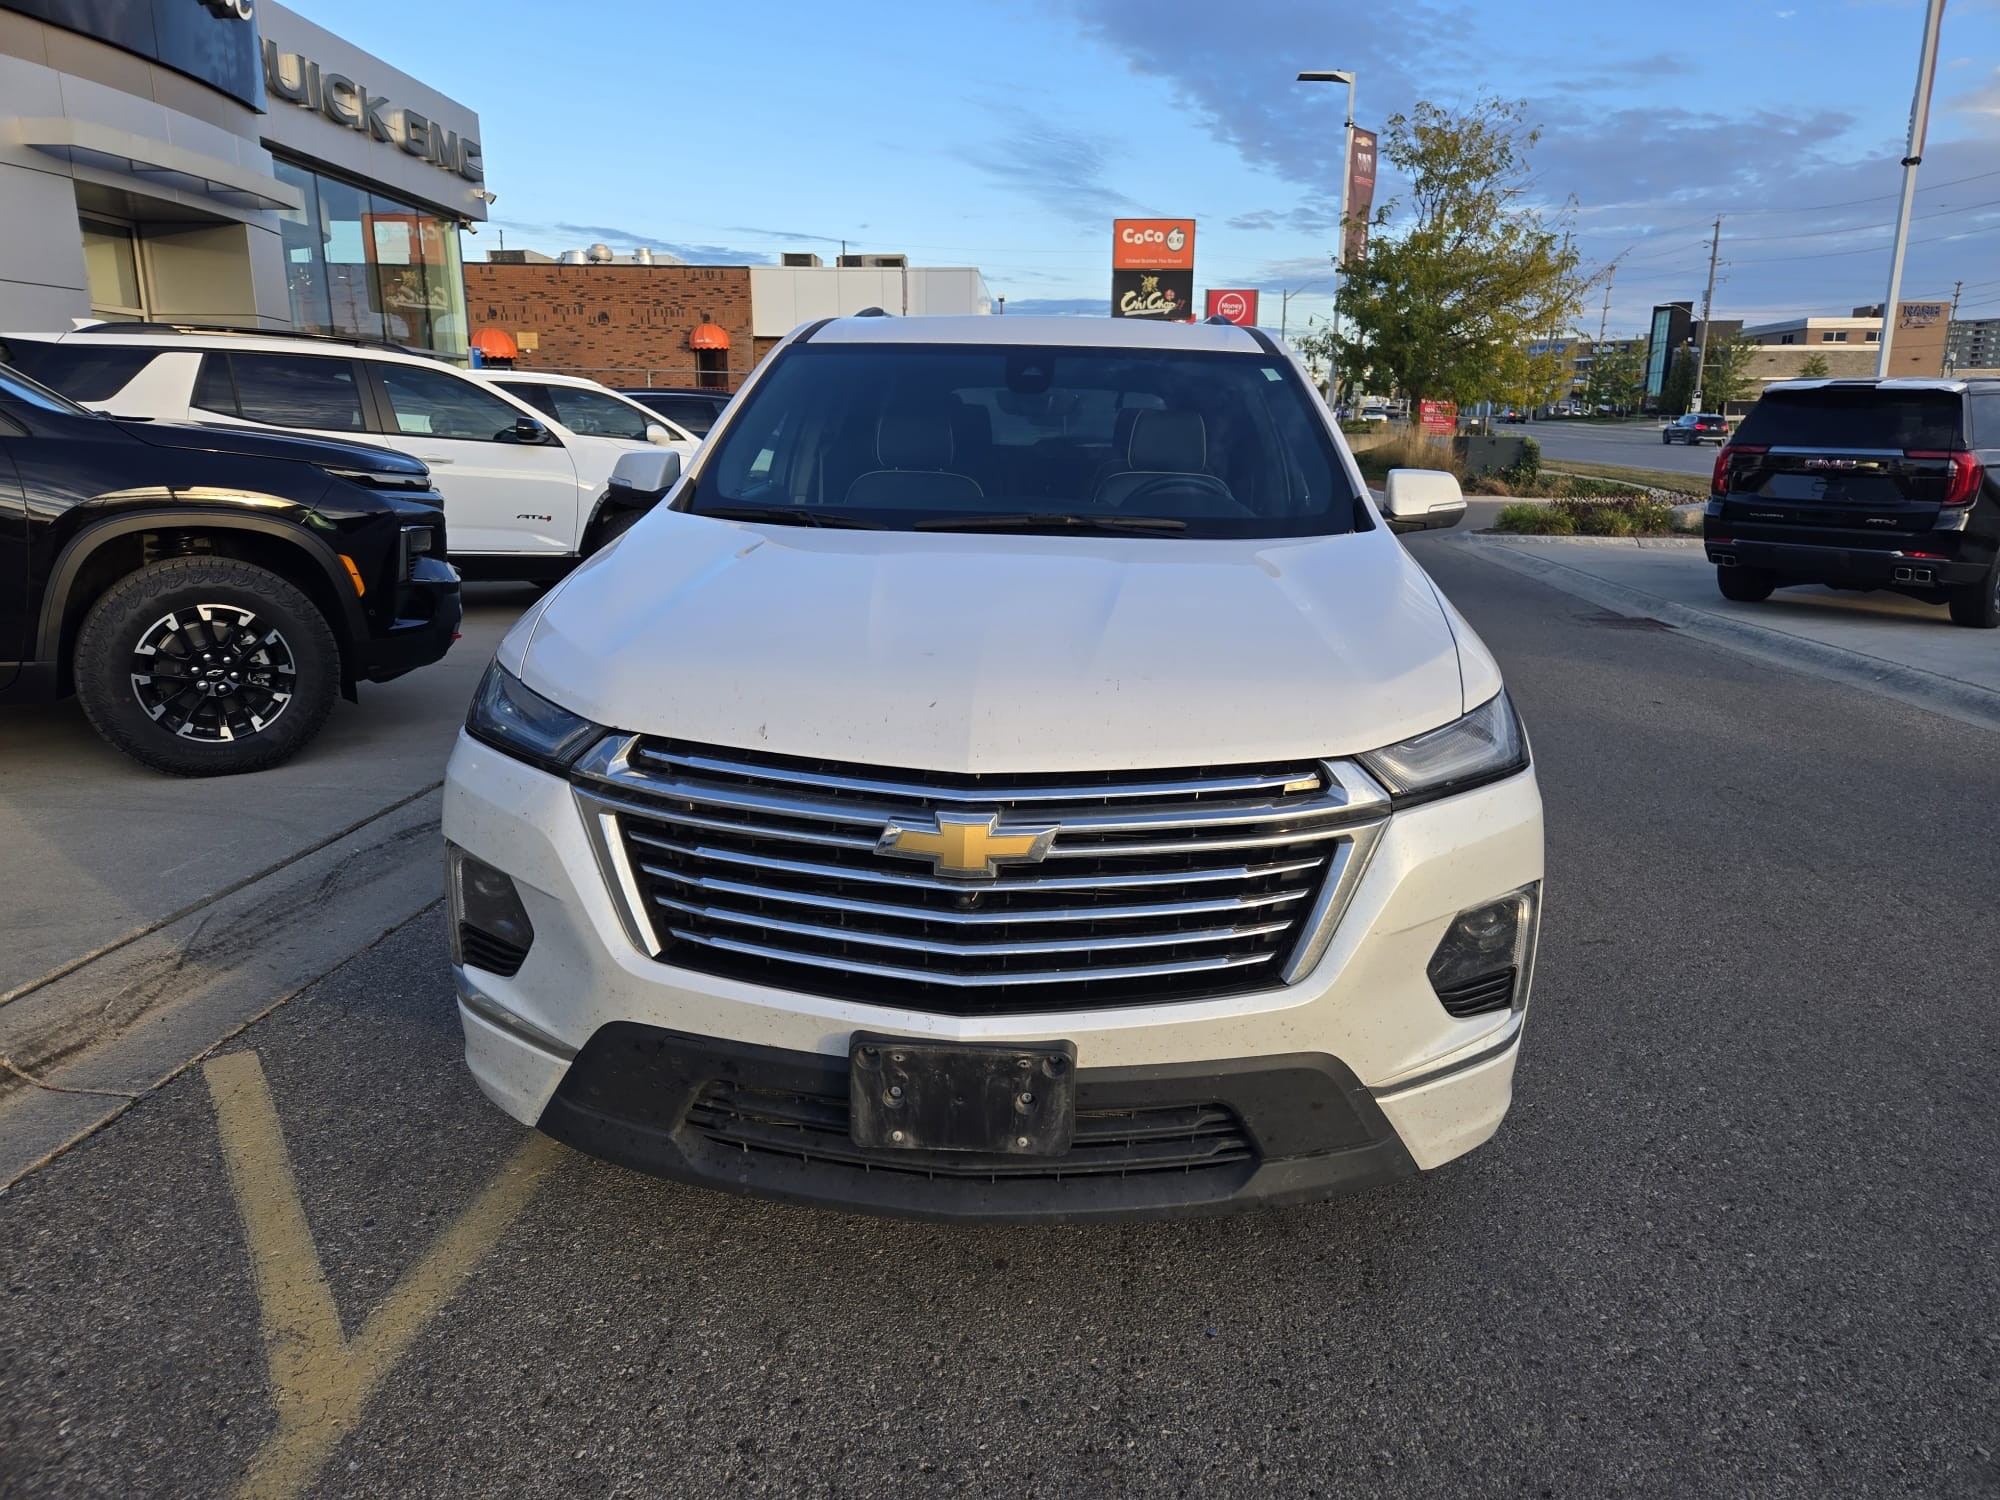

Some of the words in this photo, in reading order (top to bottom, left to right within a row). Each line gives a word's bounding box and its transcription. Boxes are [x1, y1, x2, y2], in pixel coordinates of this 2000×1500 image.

[259, 38, 393, 143] UICK
[396, 108, 484, 182] GMC
[1122, 227, 1164, 245] CoCo
[1221, 302, 1242, 311] Money
[1804, 459, 1857, 469] GMC
